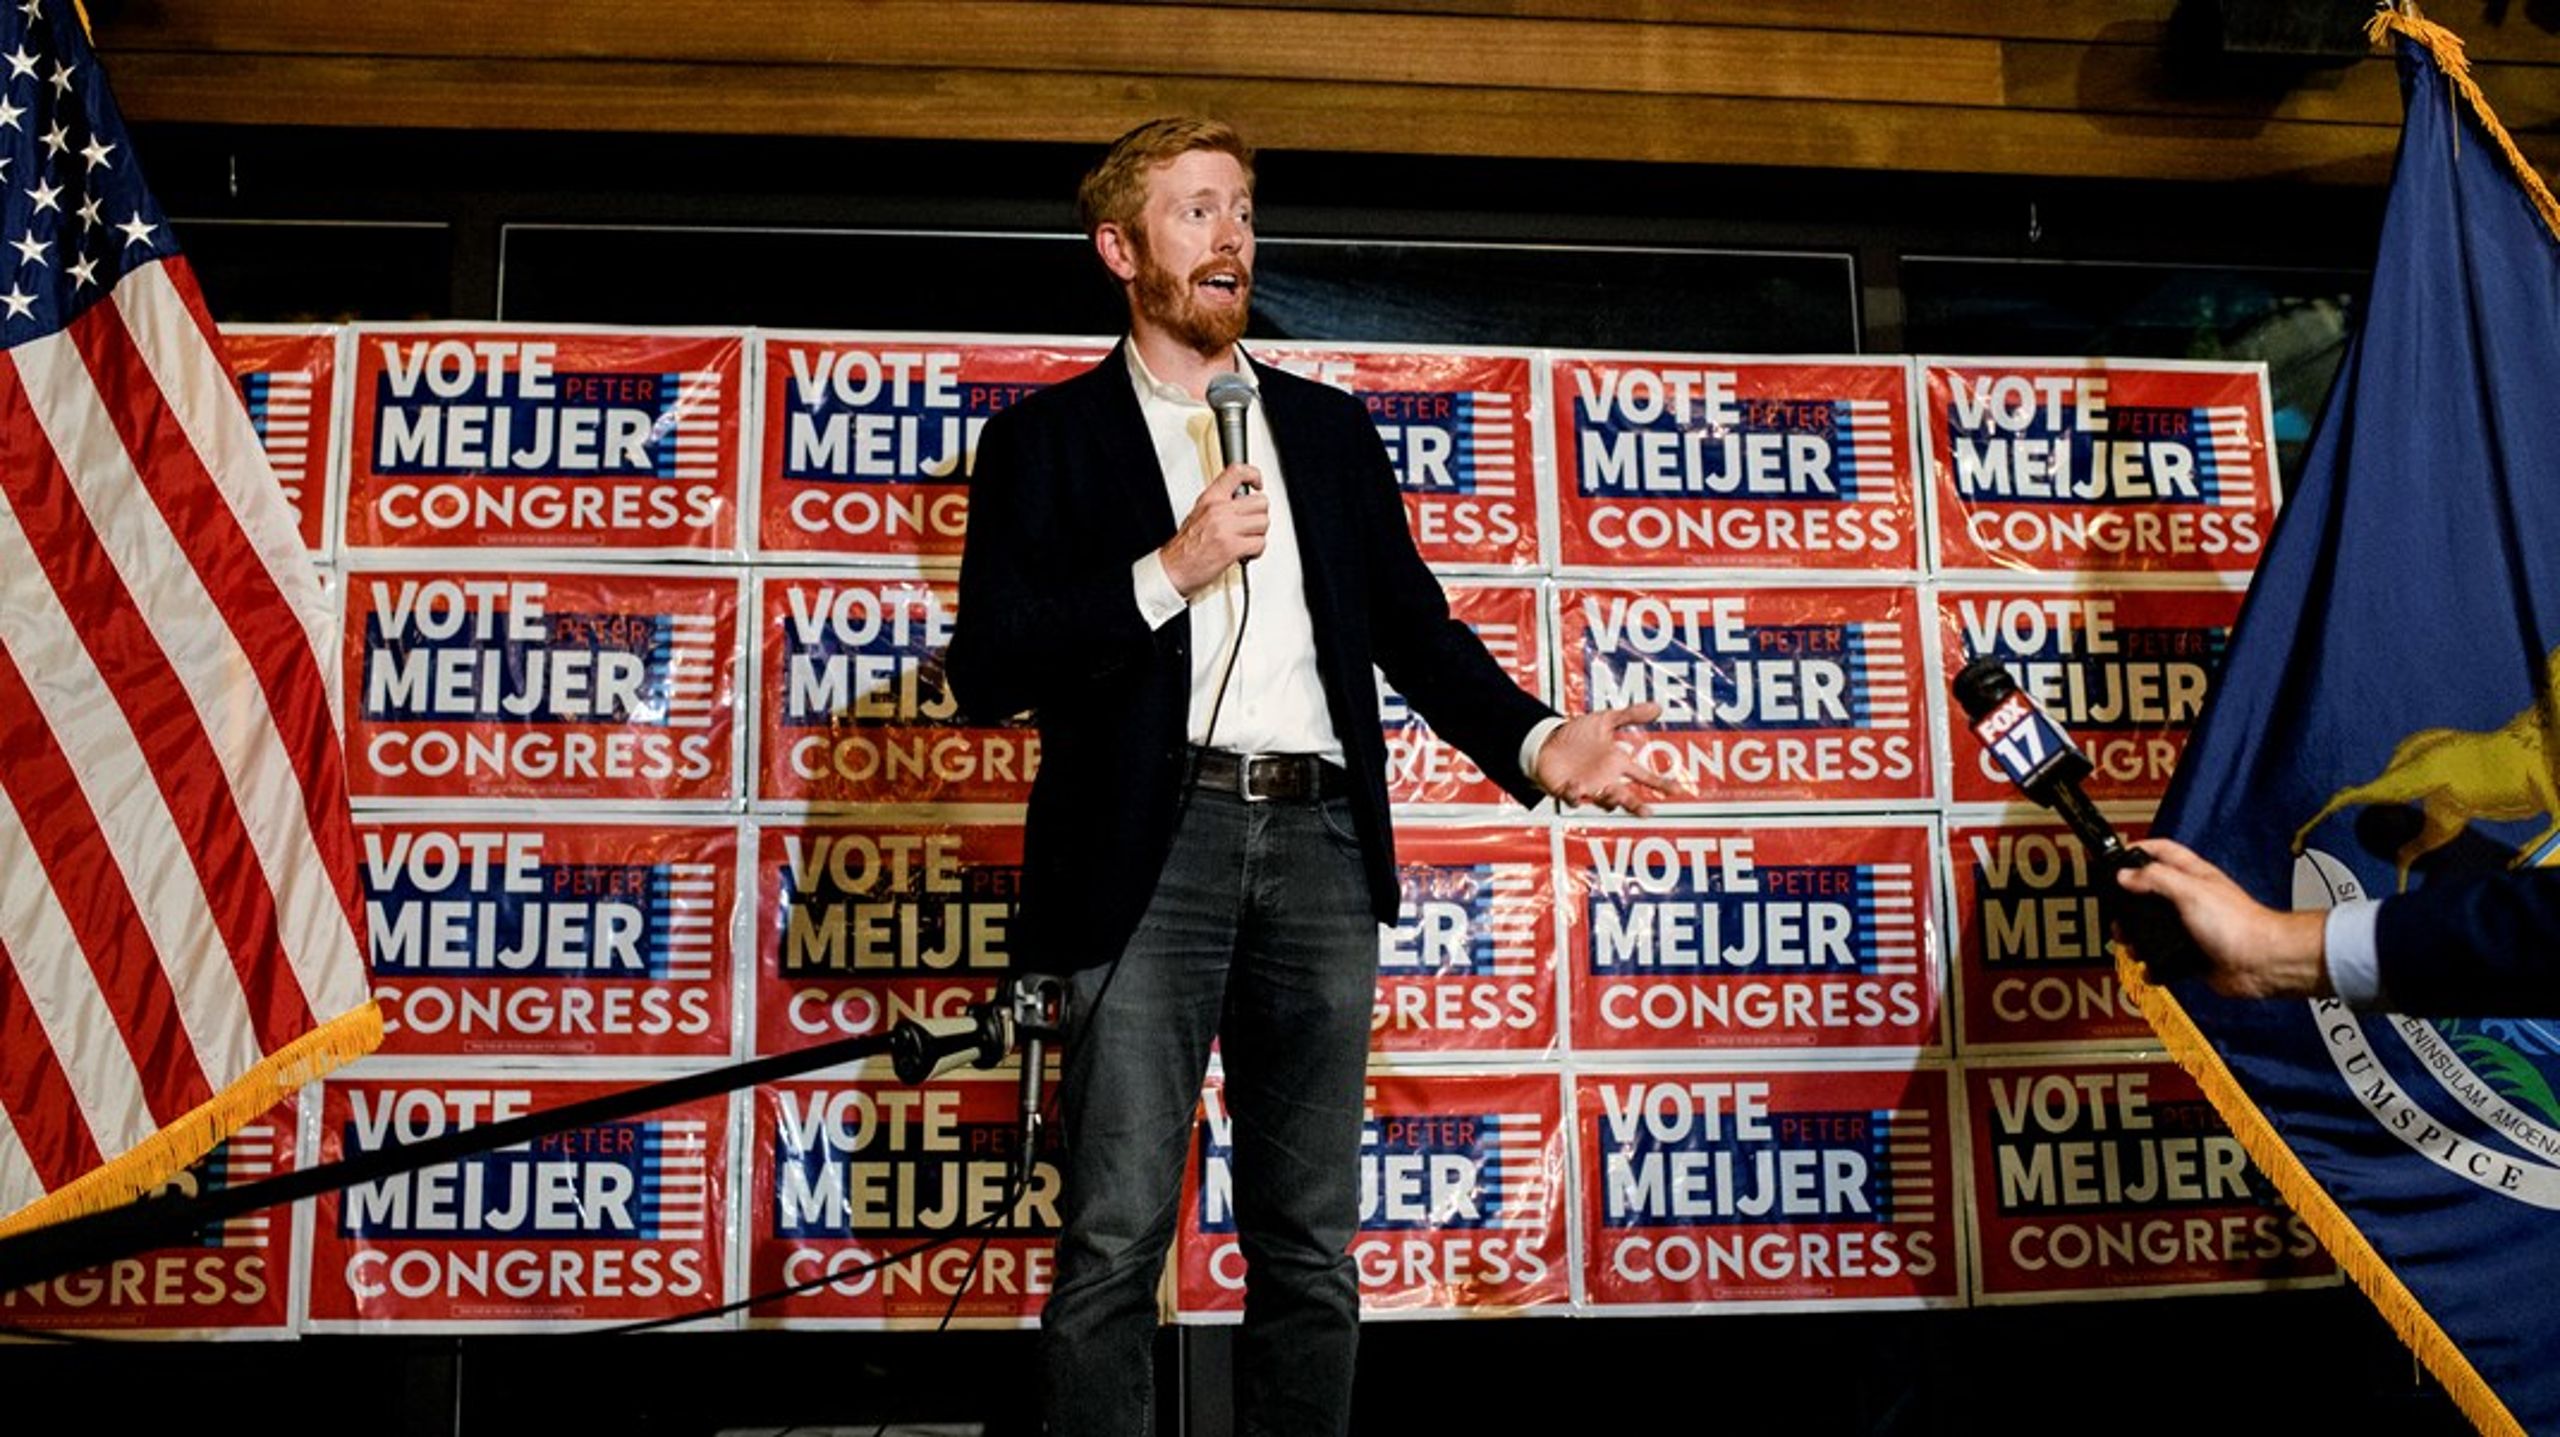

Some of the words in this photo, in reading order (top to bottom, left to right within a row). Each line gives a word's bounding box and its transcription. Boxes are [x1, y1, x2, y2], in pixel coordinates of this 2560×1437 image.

[381, 340, 556, 399] VOTE
[566, 378, 653, 400] PETER
[789, 348, 961, 409] VOTE
[1573, 368, 1741, 426] VOTE
[971, 388, 1036, 410] PET
[1366, 396, 1450, 419] PETER
[1750, 406, 1830, 427] PETER
[1948, 375, 2109, 432] VOTE
[2117, 411, 2189, 435] PETER
[379, 405, 653, 469] MEIJER
[1581, 430, 1837, 494] MEIJER
[1956, 437, 2200, 499] MEIJER
[379, 483, 717, 530] CONGRESS
[790, 489, 970, 537] CONG
[1403, 502, 1518, 545] ESS
[1587, 506, 1900, 551] CONGRESS
[1967, 510, 2261, 555] CONGRESS
[371, 580, 548, 641] VOTE
[557, 617, 649, 643] PETER
[786, 587, 960, 648] VOTE
[1581, 596, 1750, 654] VOTE
[1958, 599, 2120, 655] VOTE
[1759, 629, 1841, 652] PETER
[2128, 633, 2203, 657] PETER
[369, 648, 646, 716] MEIJER
[1590, 659, 1850, 723] MEIJER
[1977, 696, 2029, 744] FOX
[1993, 714, 2046, 776] 17
[367, 731, 712, 780] CONGRESS
[363, 832, 545, 893] VOTE
[553, 870, 646, 895] PETER
[783, 835, 963, 894] VOTE
[1588, 836, 1759, 895] VOTE
[1768, 870, 1850, 895] PETER
[367, 901, 644, 970] MEIJER
[787, 902, 1010, 970] MEIJE
[1595, 902, 1856, 968] MEIJER
[1600, 981, 1921, 1030] CONGRESS
[348, 1088, 531, 1152] VOTE
[778, 1089, 961, 1153] VOTE
[1599, 1082, 1772, 1144] VOTE
[1782, 1118, 1865, 1143] PETER
[1988, 1073, 2153, 1134] VOTE
[542, 1127, 635, 1154] PETER
[1387, 1122, 1475, 1147] PETER
[345, 1160, 636, 1231] MEIJER
[781, 1161, 1063, 1230] MEIJER
[1606, 1149, 1872, 1218] MEIJER
[1998, 1136, 2252, 1208] MEIJER
[1613, 1231, 1937, 1283] CONGRESS
[2009, 1215, 2318, 1271] CONGRESS
[345, 1248, 703, 1298] CONGRESS
[782, 1247, 1055, 1297] CONGRE
